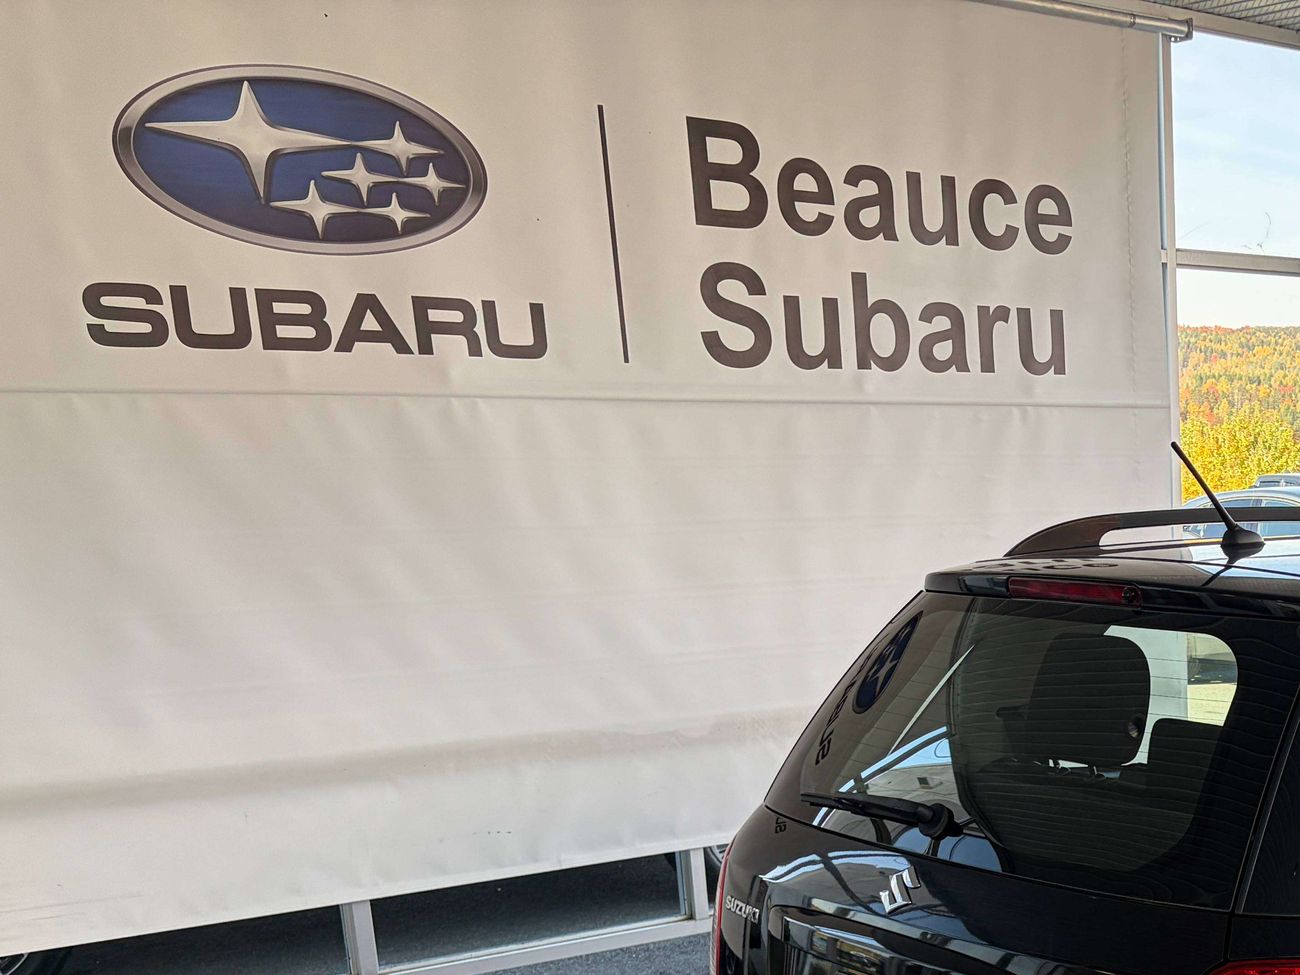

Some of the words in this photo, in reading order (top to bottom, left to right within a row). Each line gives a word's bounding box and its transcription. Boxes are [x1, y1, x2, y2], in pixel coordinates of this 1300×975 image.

[685, 115, 1073, 255] Beauce
[81, 282, 548, 360] SUBARU
[700, 261, 1067, 375] Subaru
[725, 895, 760, 924] SUZUKI
